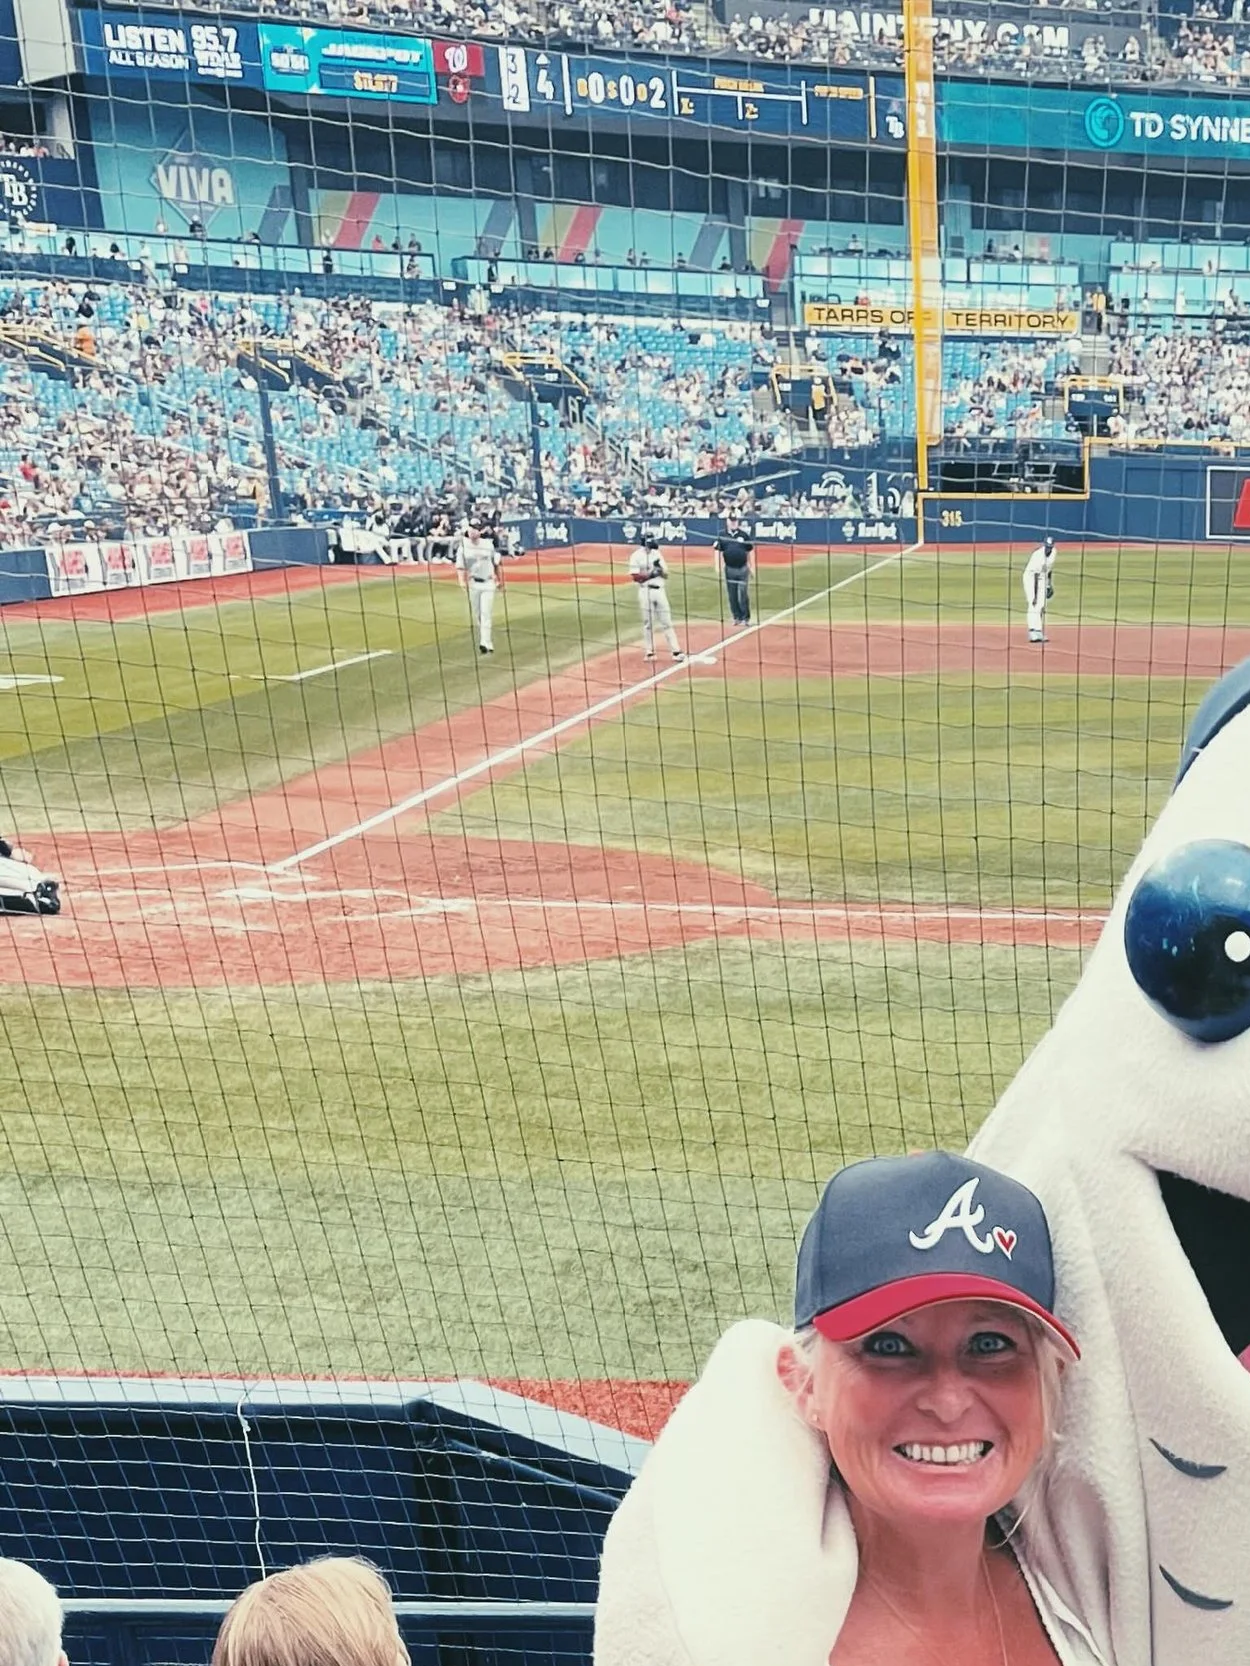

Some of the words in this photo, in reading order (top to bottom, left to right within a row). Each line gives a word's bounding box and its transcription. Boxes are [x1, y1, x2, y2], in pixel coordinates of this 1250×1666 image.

[103, 23, 188, 53] LISTEN
[190, 24, 238, 52] 95.7
[109, 50, 135, 66] ALL
[136, 52, 190, 69] SEASON
[507, 53, 518, 74] 3
[507, 83, 522, 104] 2
[536, 68, 554, 100] 4
[649, 77, 667, 108] 2
[1130, 111, 1164, 139] TD
[156, 164, 234, 204] VIVA
[951, 312, 1069, 330] TERRITORY
[942, 510, 963, 528] 315
[908, 1176, 995, 1254] A
